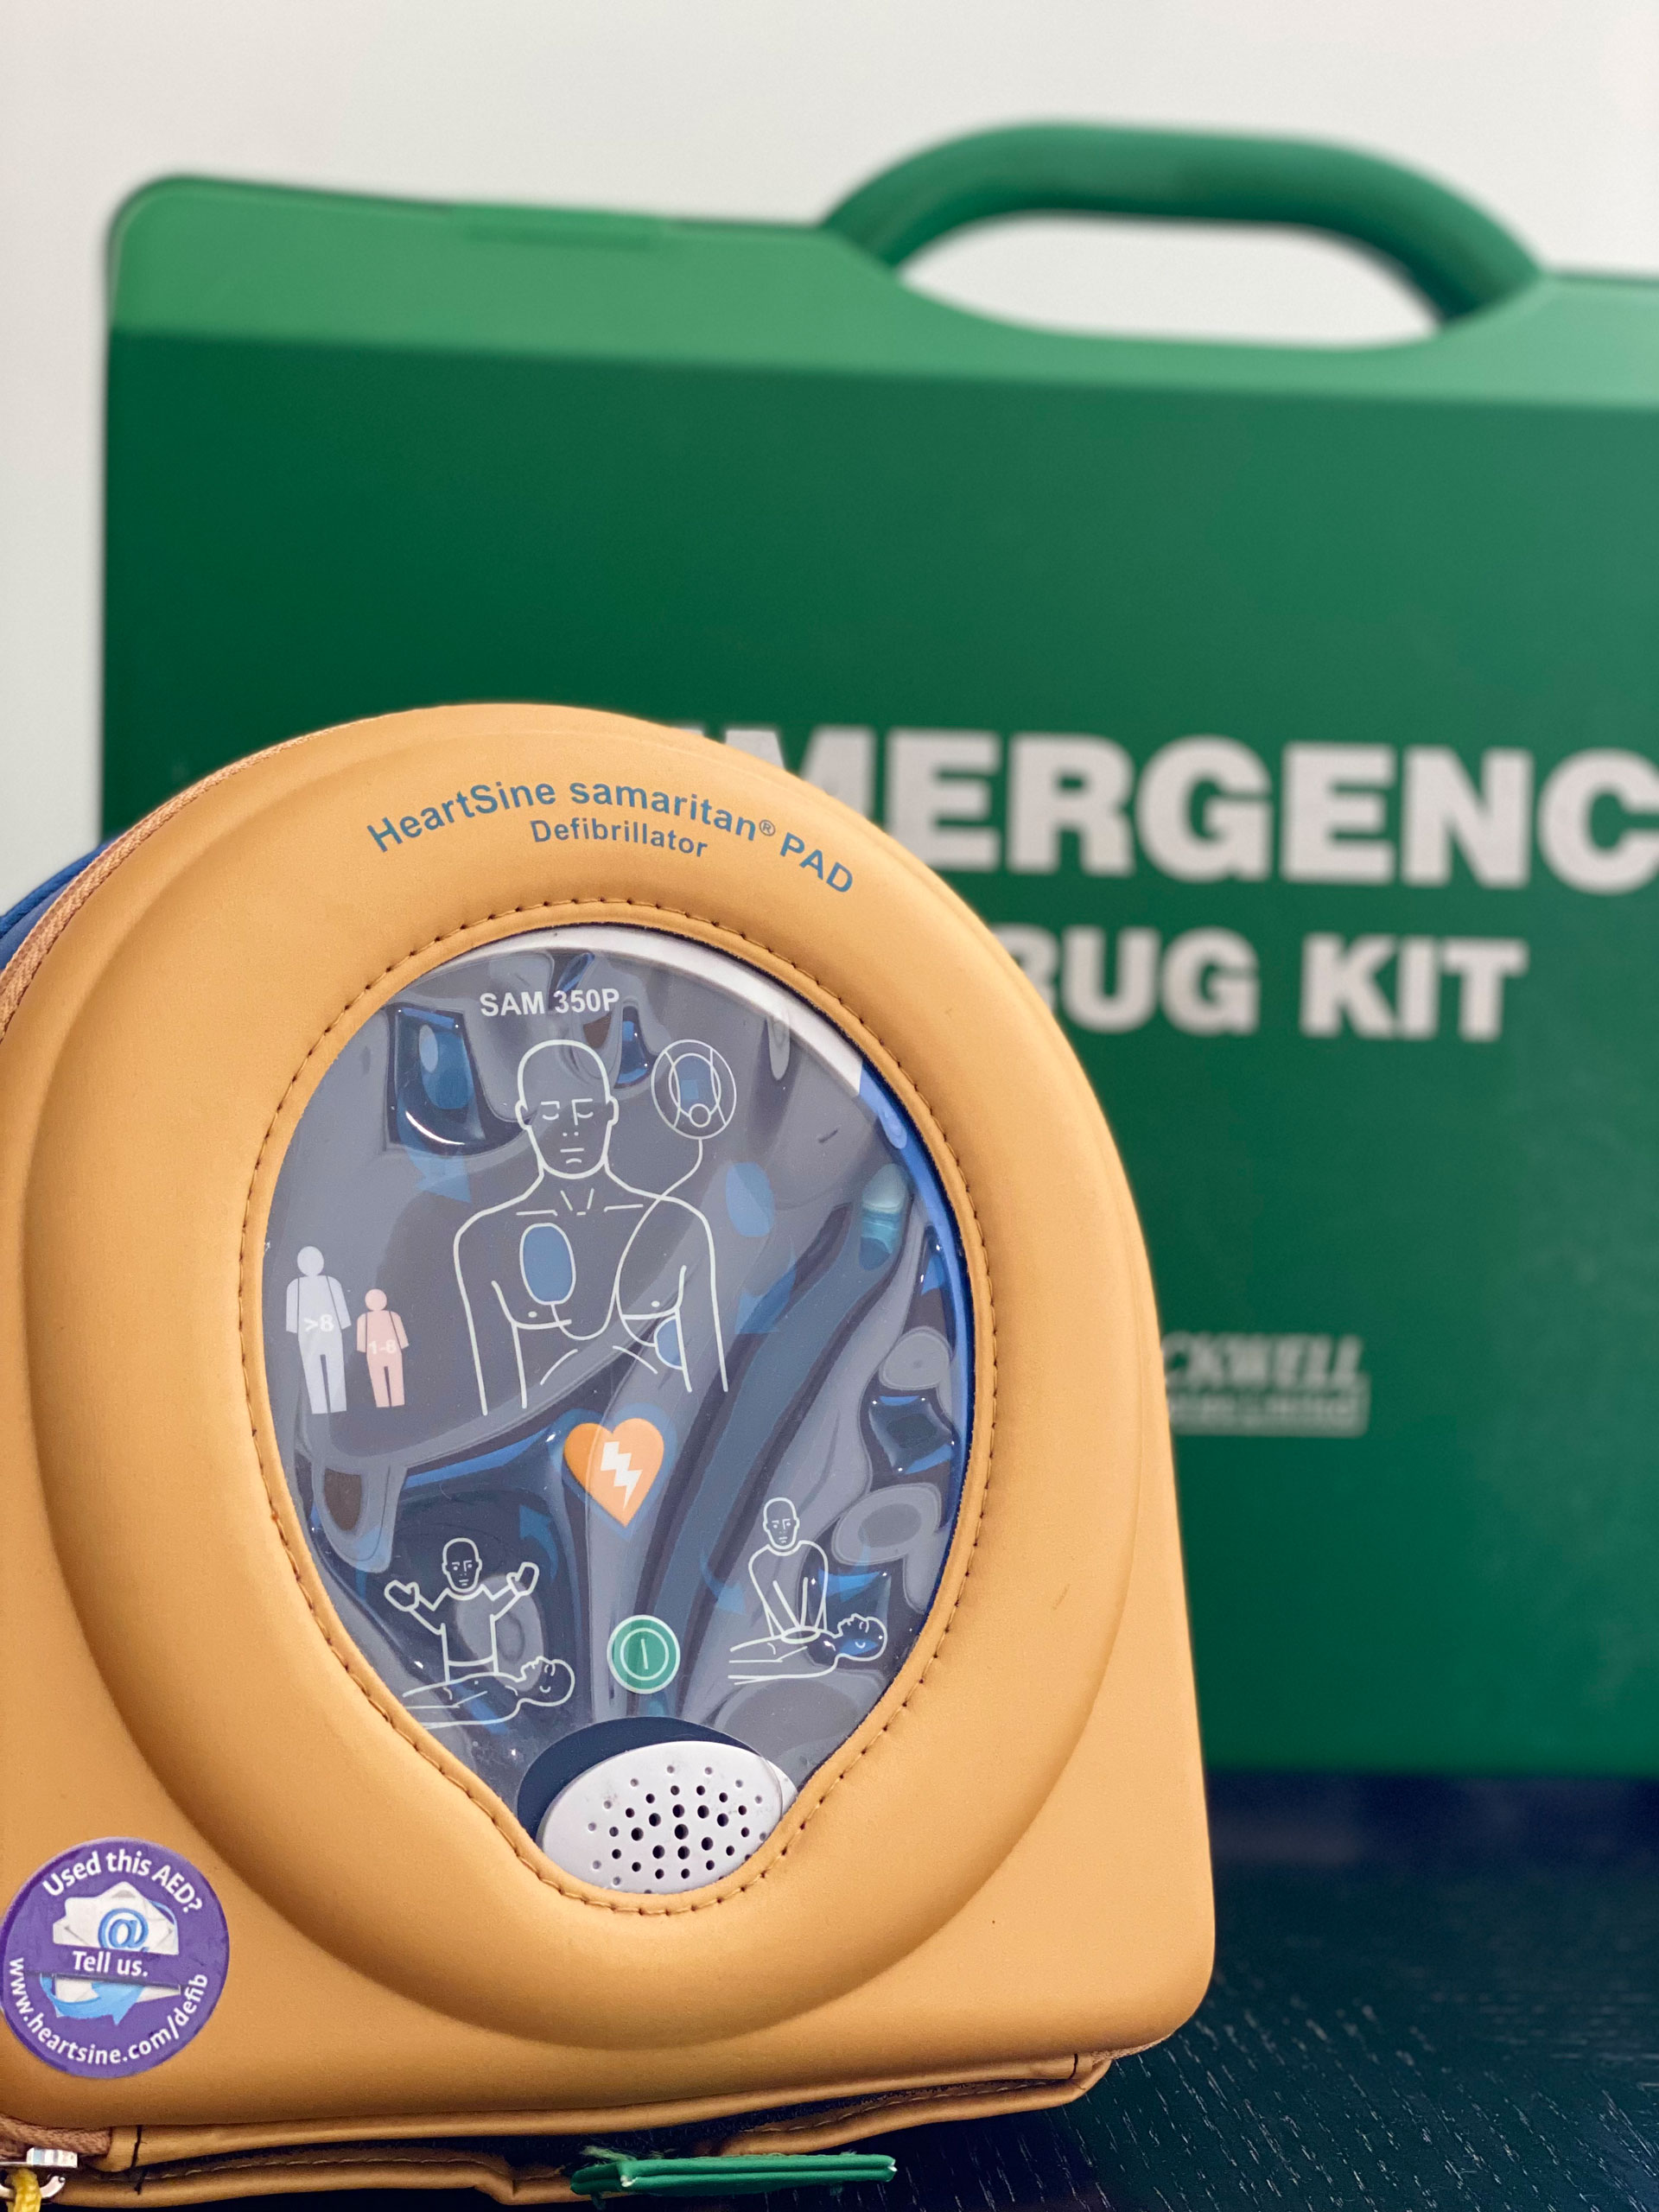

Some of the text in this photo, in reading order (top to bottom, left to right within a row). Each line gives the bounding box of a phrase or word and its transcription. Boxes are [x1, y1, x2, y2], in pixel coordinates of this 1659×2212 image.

[367, 781, 556, 853] HeartSine
[779, 831, 855, 893] PAD
[530, 817, 709, 858] Defibrillator
[667, 722, 1659, 897] ERGENC
[479, 987, 620, 1018] SAM 350P
[1300, 932, 1529, 1042] KIT
[42, 1848, 203, 1914] Used this AED?
[72, 1949, 149, 1978] Tell us.
[9, 1956, 209, 2065] www.heartsine.com/defib
